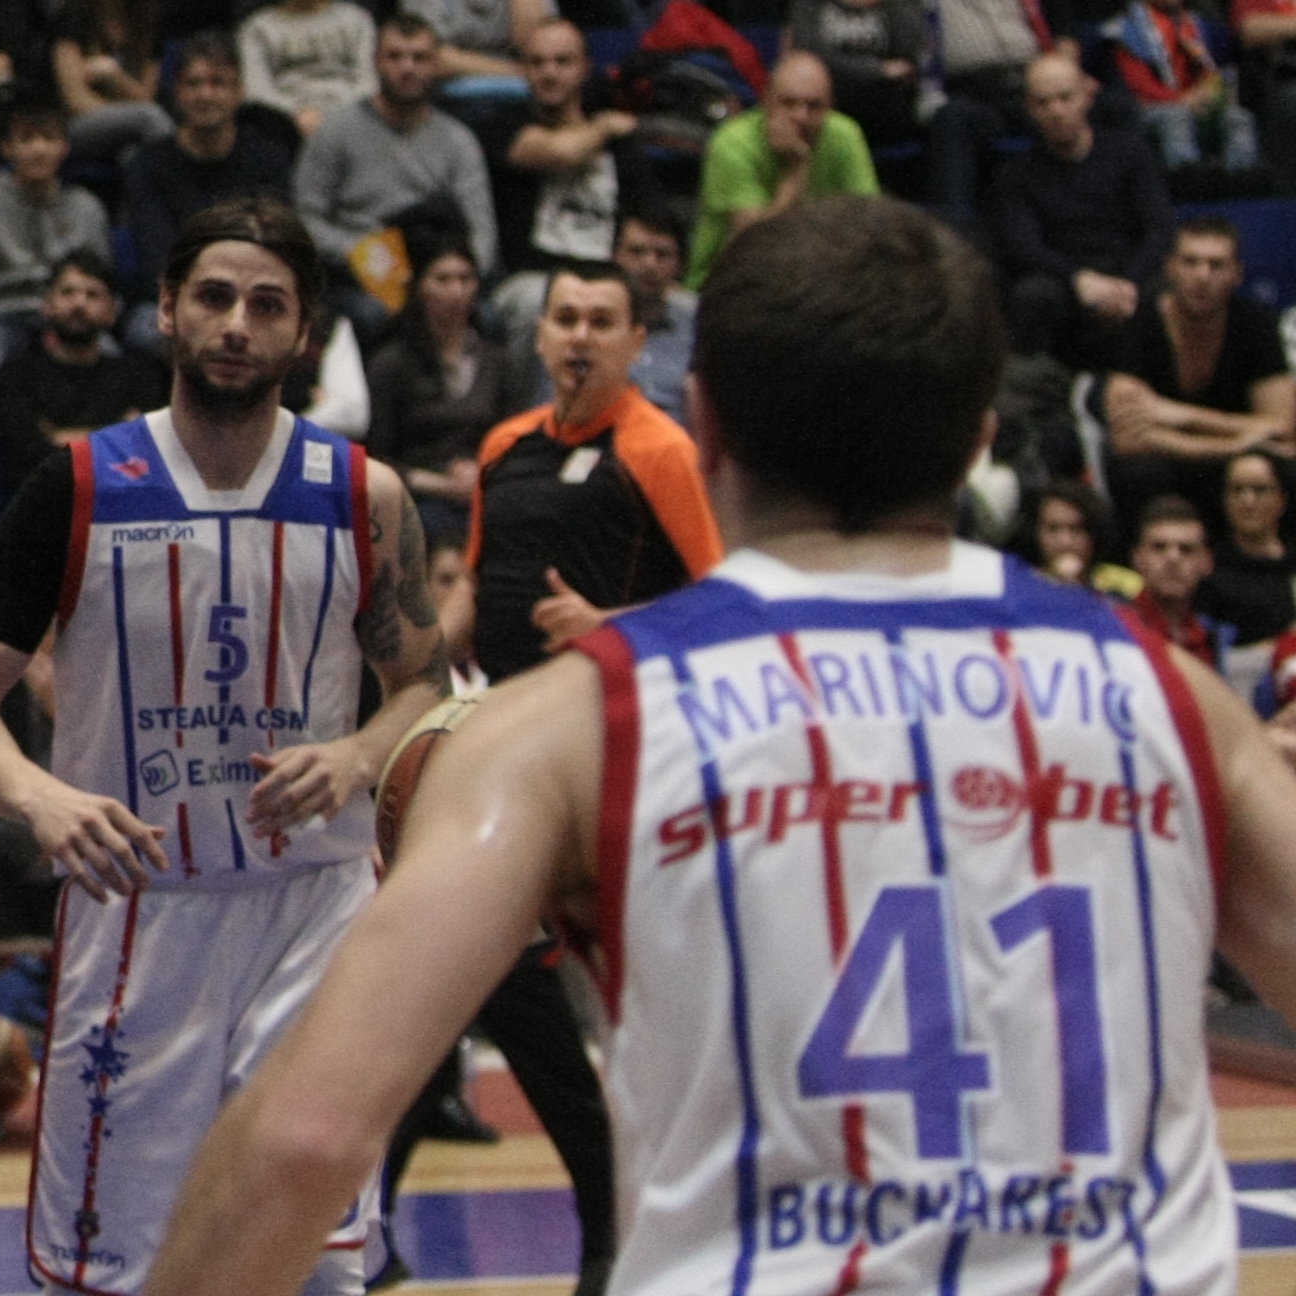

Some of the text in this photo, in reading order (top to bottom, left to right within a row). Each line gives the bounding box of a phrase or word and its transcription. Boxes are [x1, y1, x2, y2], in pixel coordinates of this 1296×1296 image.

[112, 524, 195, 543] macron
[203, 605, 250, 684] 5
[137, 705, 248, 731] STEAUA
[187, 758, 260, 787] Exim
[657, 763, 1177, 867] super bet
[796, 886, 1111, 1160] 41
